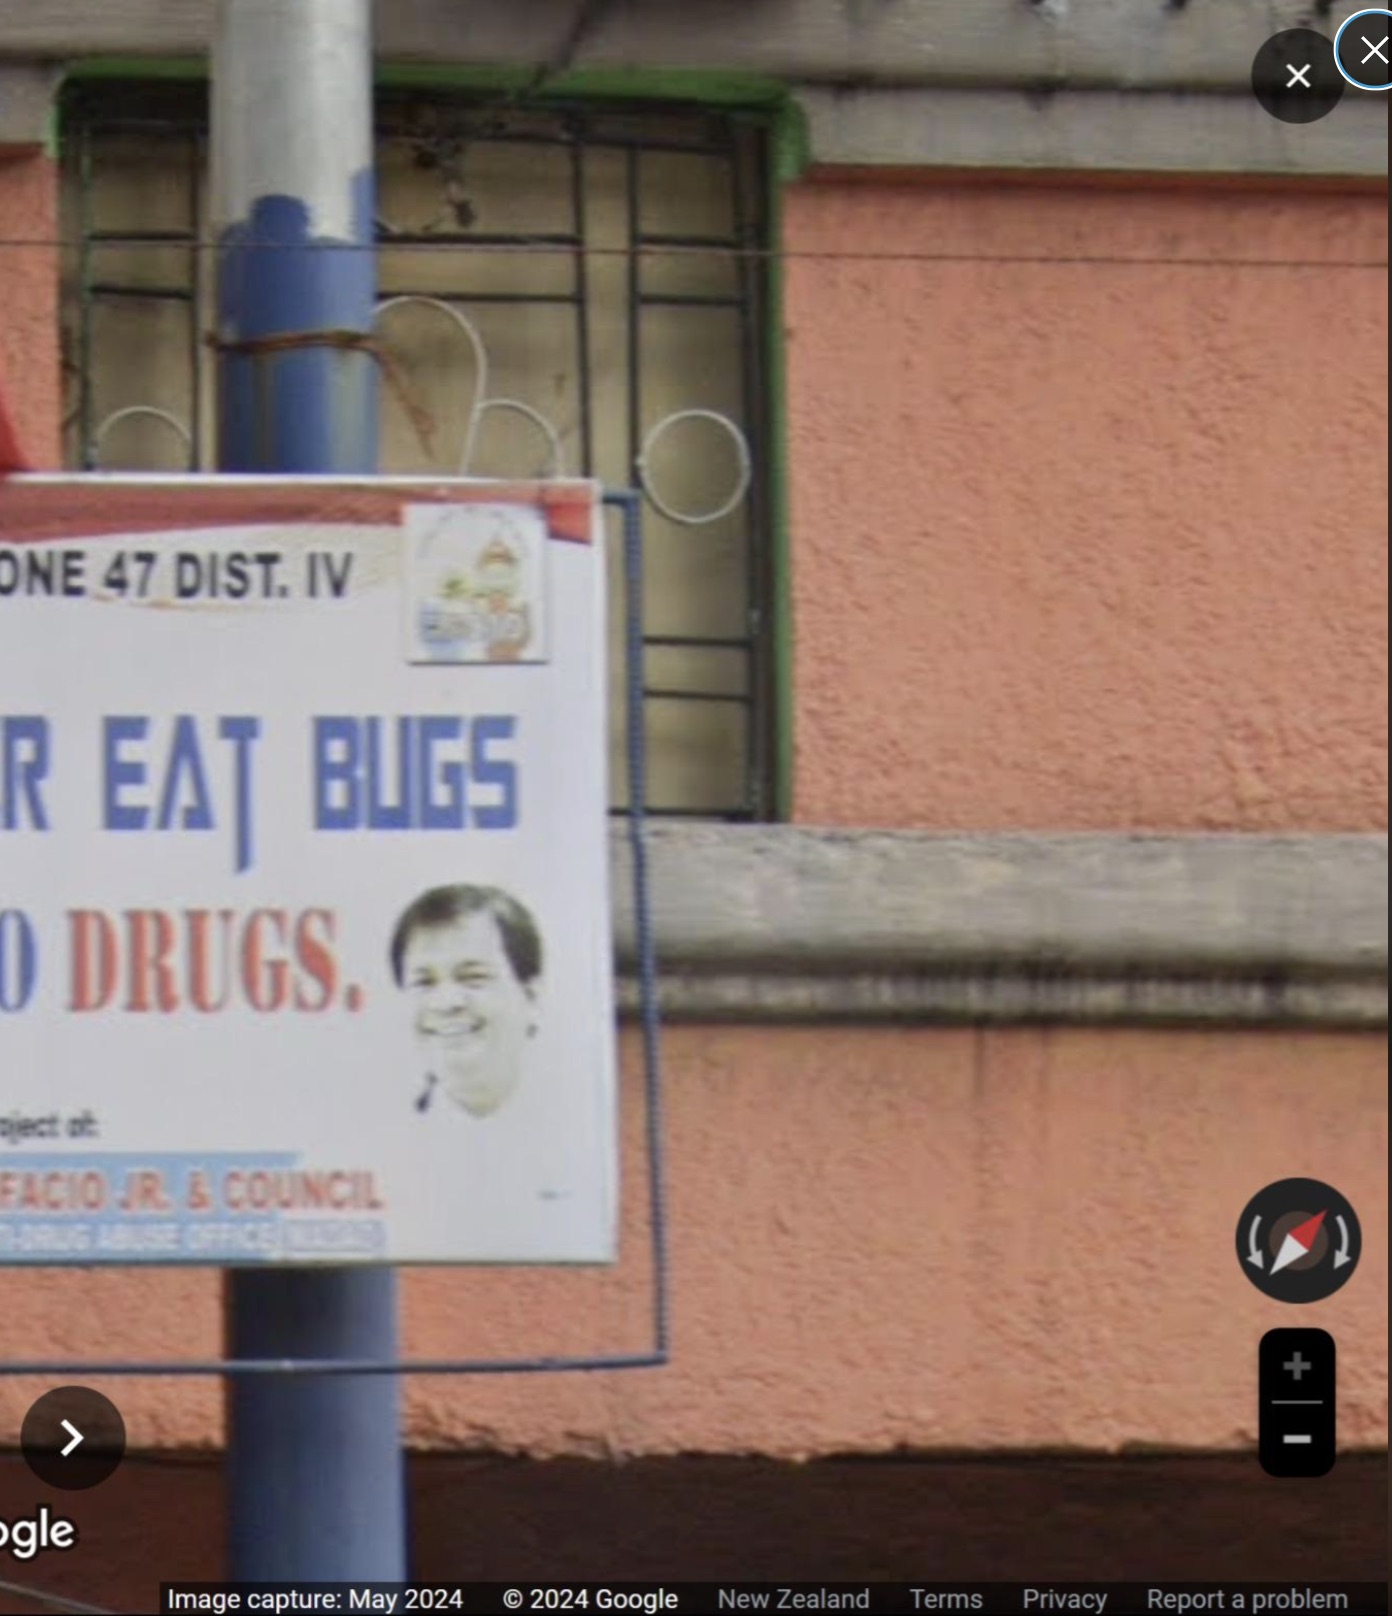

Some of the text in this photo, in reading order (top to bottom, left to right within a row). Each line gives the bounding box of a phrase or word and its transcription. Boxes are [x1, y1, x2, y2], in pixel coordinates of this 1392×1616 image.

[101, 550, 158, 598] 47
[174, 551, 289, 599] DIST.
[308, 551, 354, 599] IV
[101, 714, 262, 875] EAT
[313, 715, 519, 832] BUGS
[65, 908, 365, 1014] DRUGS.
[187, 1170, 210, 1211] &
[222, 1169, 385, 1212] COUNCIL
